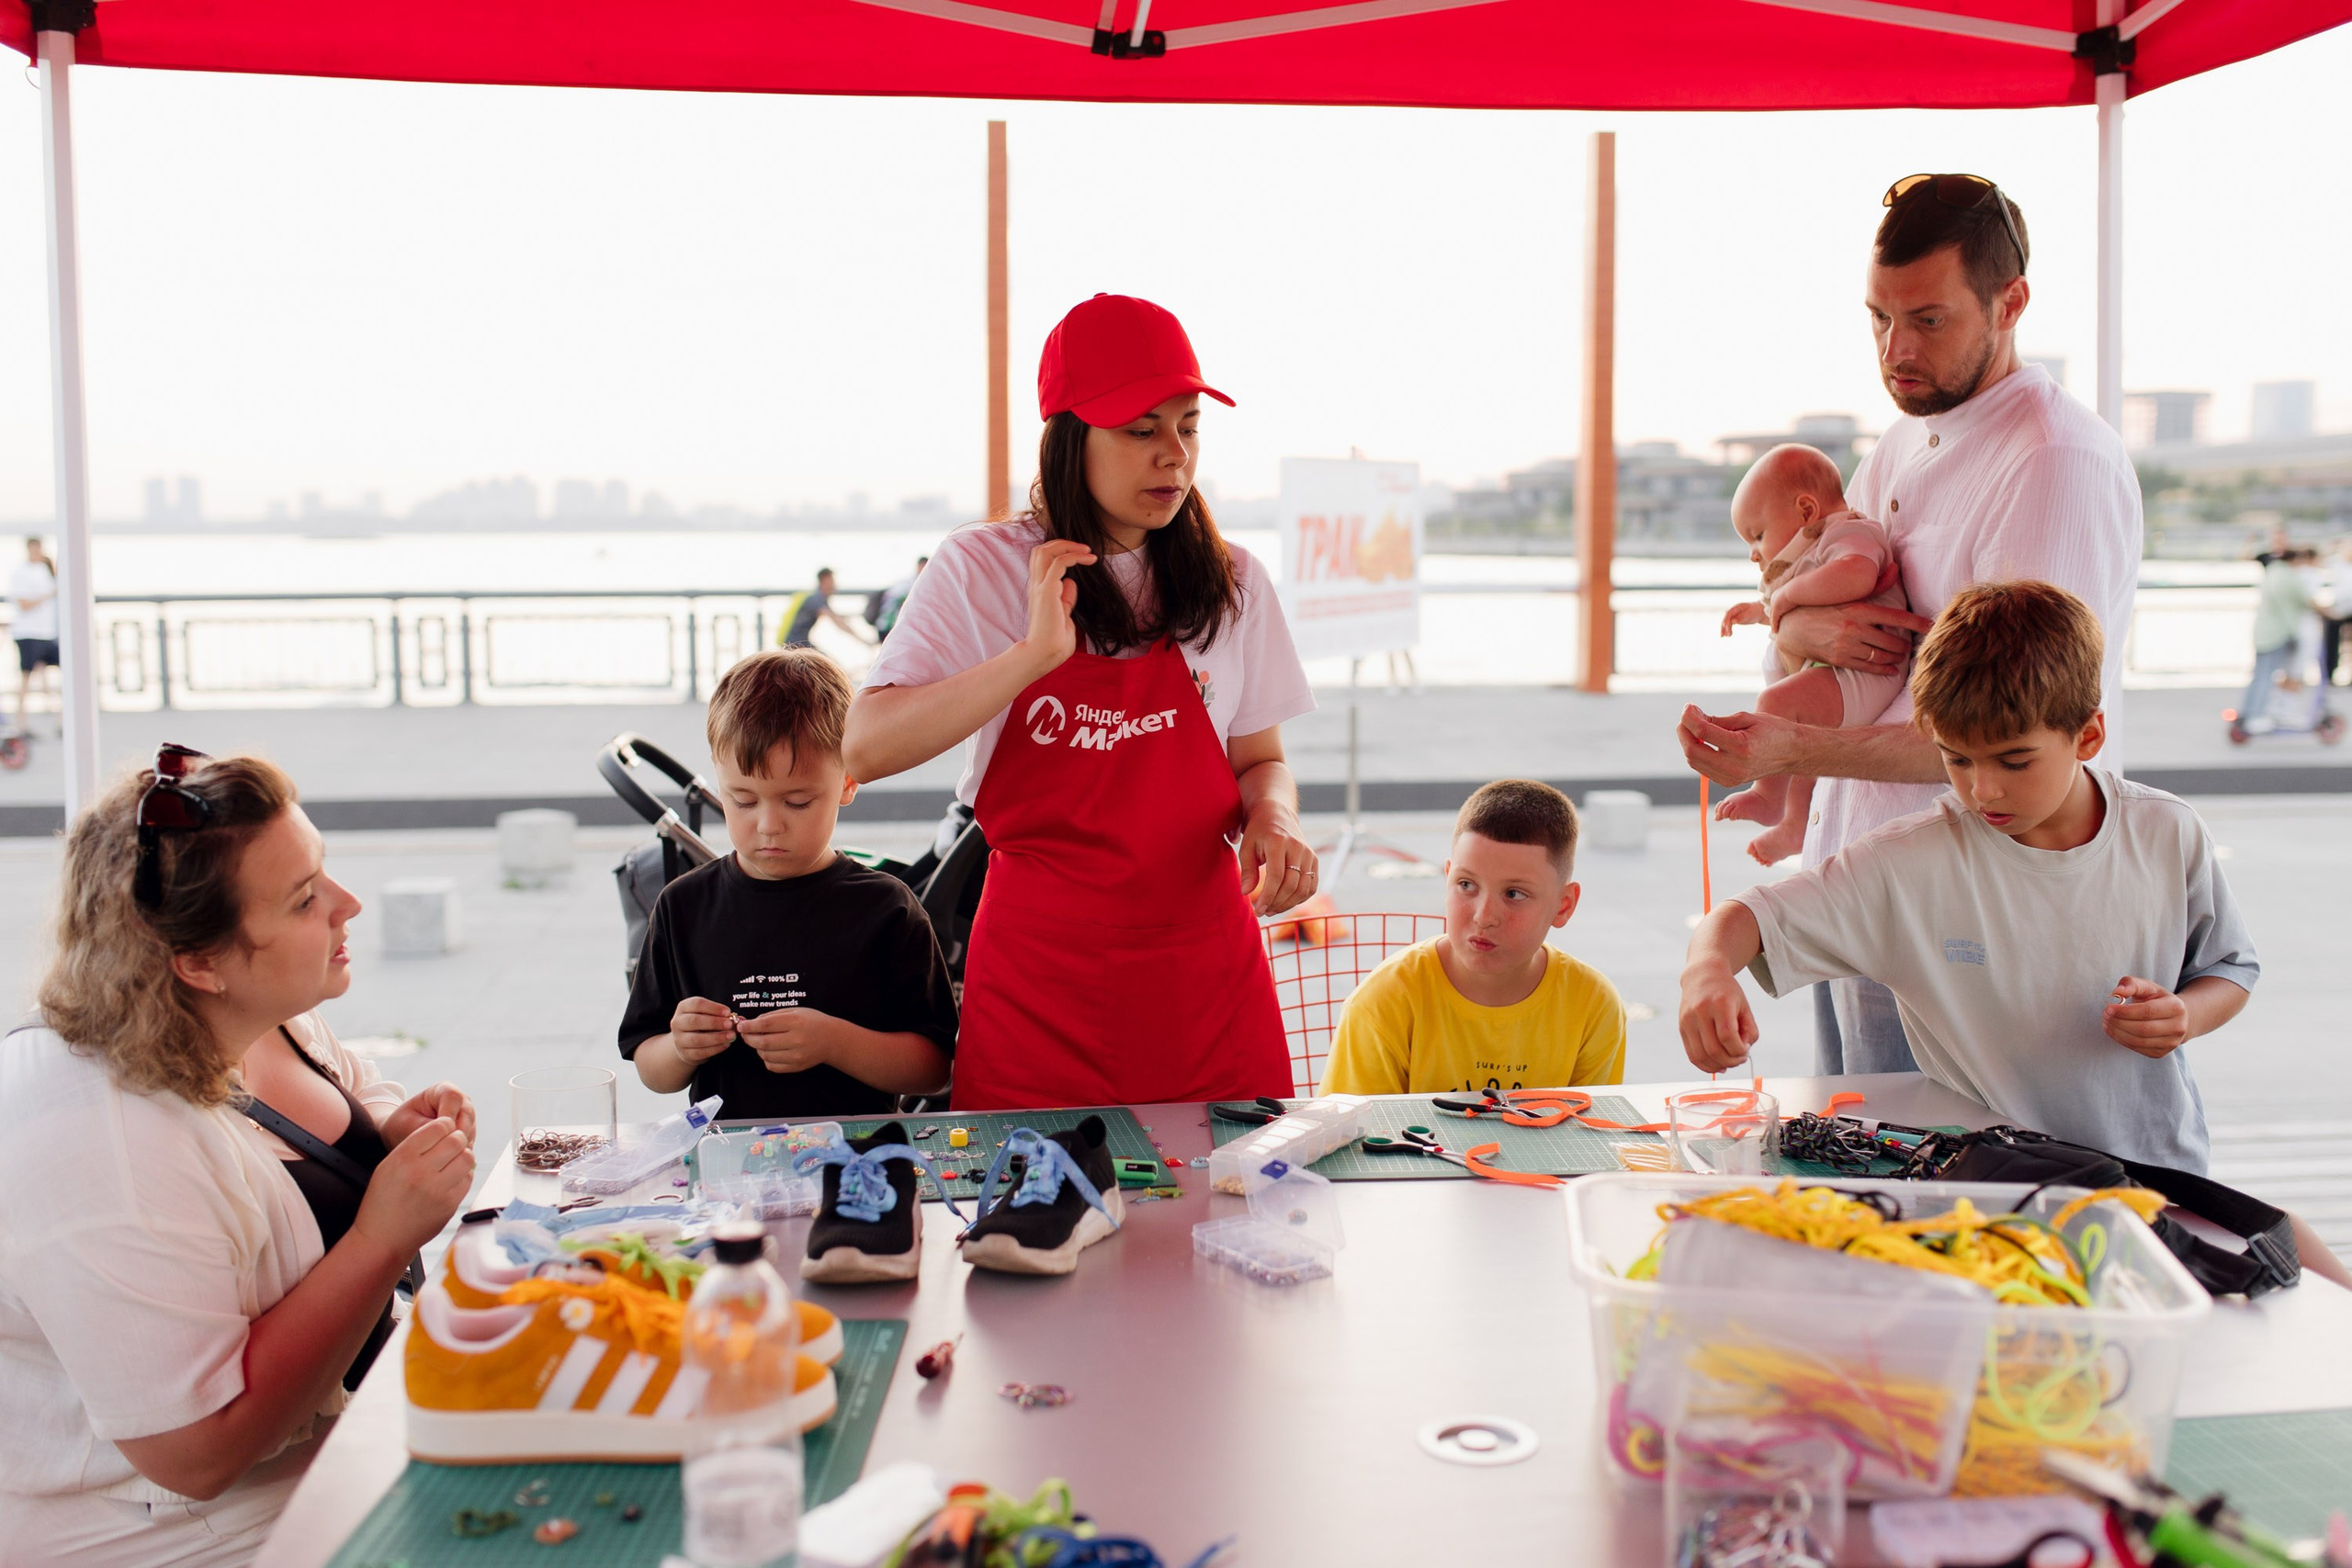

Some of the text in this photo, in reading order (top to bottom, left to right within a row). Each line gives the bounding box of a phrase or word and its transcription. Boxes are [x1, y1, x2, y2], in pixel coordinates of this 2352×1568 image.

[1944, 949, 1985, 966] VIBE
[732, 993, 748, 1001] your
[749, 991, 761, 999] life
[771, 992, 787, 1000] your
[775, 998, 798, 1007] trends
[1515, 1064, 1528, 1072] UP
